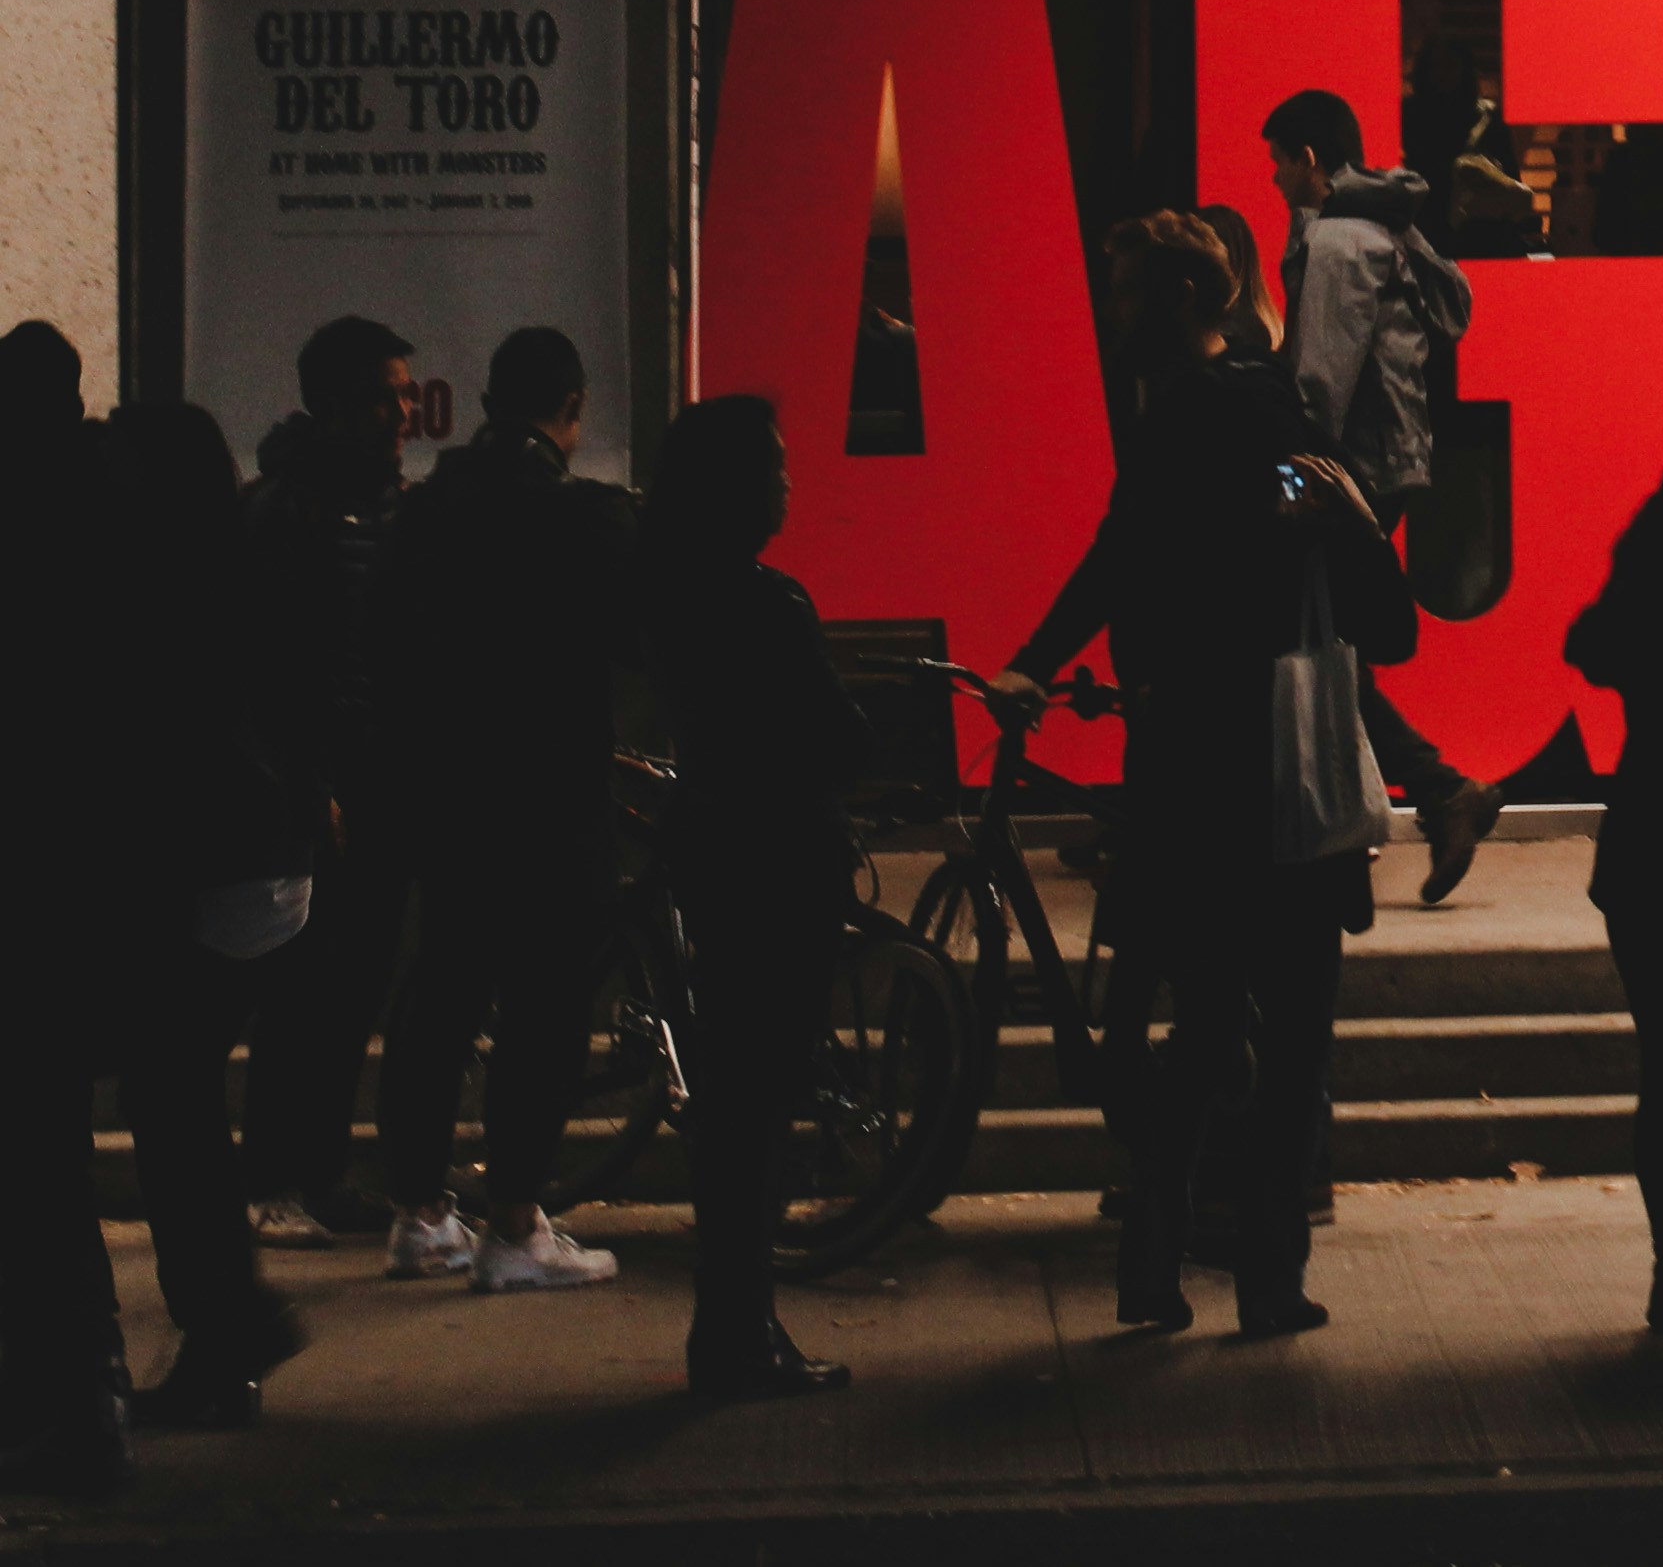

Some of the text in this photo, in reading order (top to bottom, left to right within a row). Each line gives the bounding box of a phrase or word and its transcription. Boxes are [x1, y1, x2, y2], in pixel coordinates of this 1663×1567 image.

[254, 9, 560, 68] GUILLERMO
[273, 74, 542, 133] DEL TORO
[269, 151, 299, 175] AT
[369, 151, 429, 175] WITH
[438, 151, 547, 175] MONSTERS
[399, 378, 454, 441] GO
